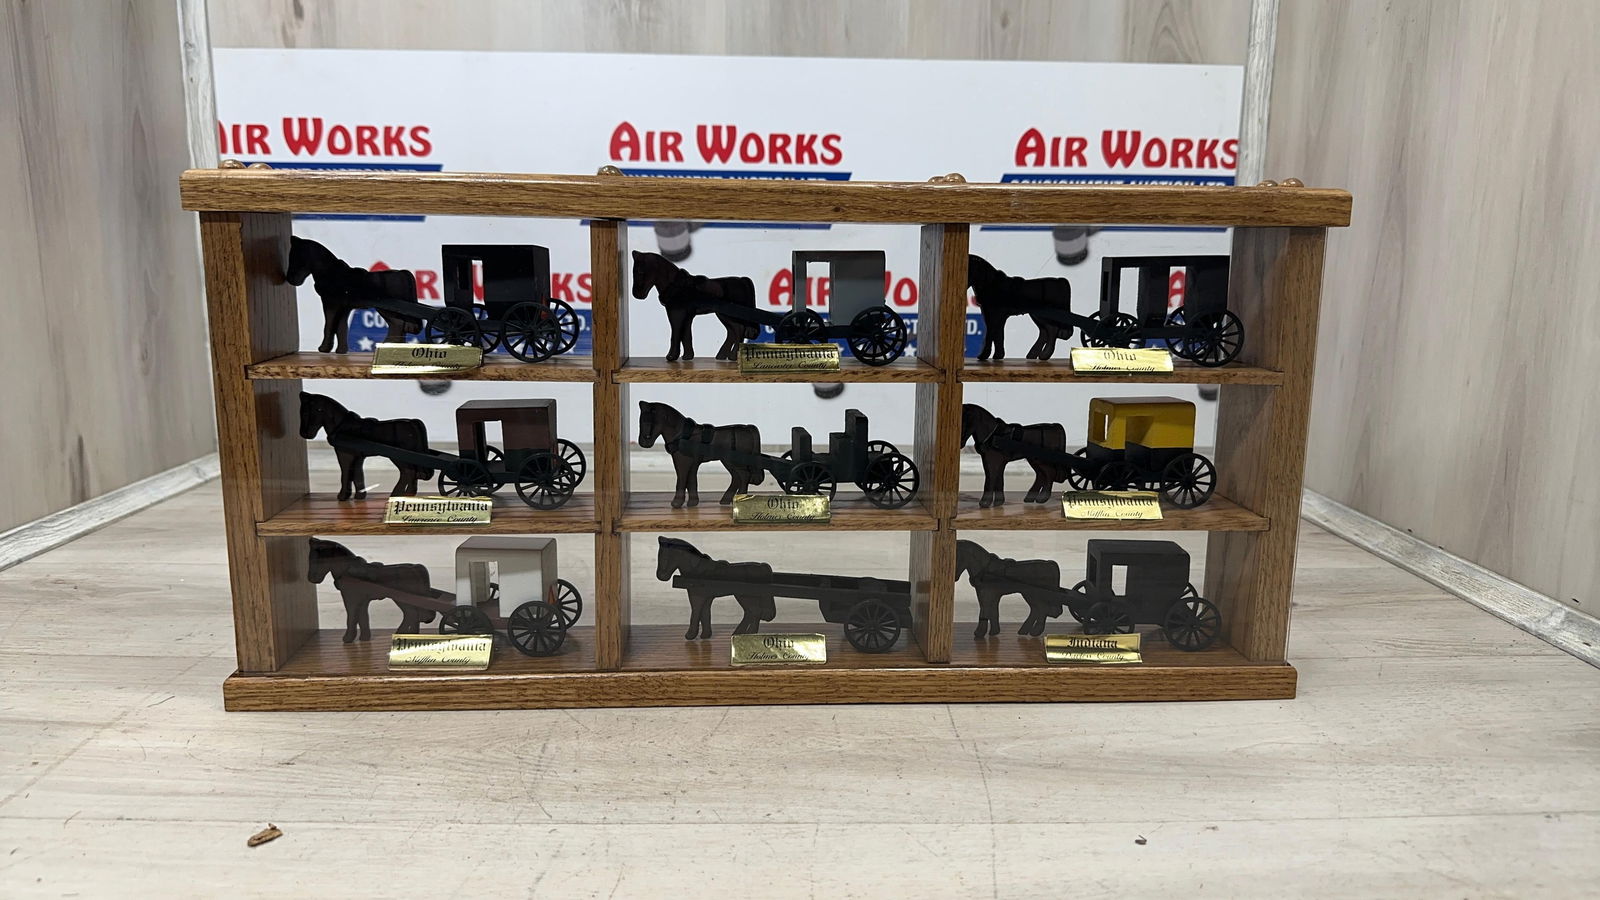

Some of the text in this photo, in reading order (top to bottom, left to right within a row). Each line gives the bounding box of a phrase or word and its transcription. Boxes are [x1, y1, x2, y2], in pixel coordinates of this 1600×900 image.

[282, 117, 432, 157] WORKS
[609, 121, 843, 165] AIR WORKS
[1014, 127, 1240, 169] AIR WORKS
[411, 347, 447, 361] Ohio
[797, 360, 827, 369] County
[394, 501, 488, 515] Pennsylvania
[767, 497, 799, 511] Ohio
[446, 514, 478, 523] County
[763, 636, 795, 650] Ohio
[1068, 637, 1118, 649] Indiana
[441, 656, 471, 665] County
